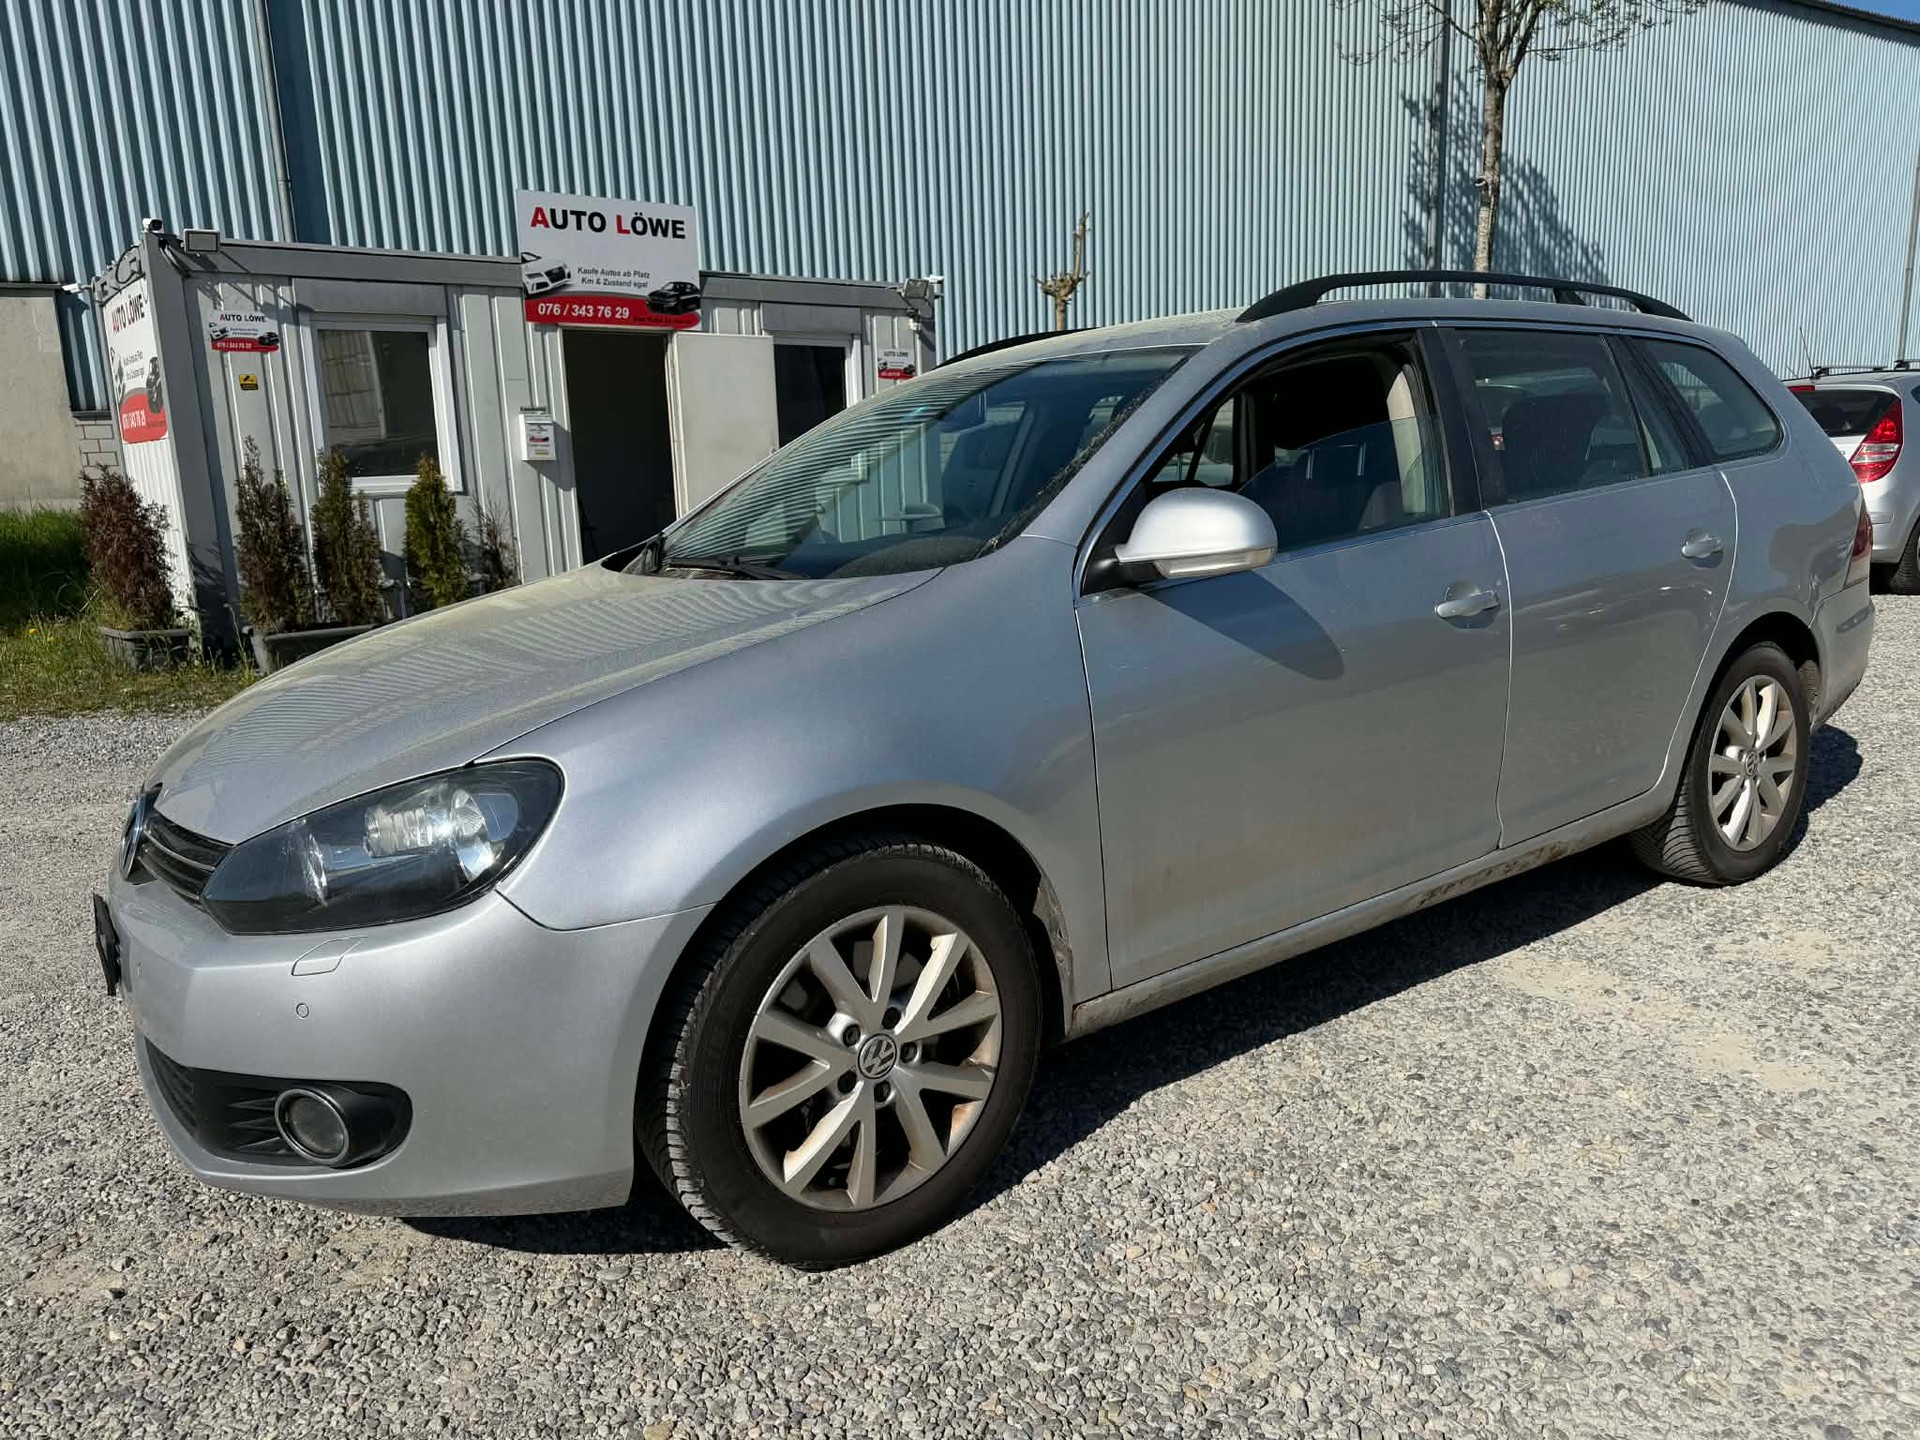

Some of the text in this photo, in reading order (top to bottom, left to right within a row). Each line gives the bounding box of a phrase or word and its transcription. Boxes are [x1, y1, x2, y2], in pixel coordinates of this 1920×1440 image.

[530, 206, 686, 239] AUTO LÖWE
[577, 267, 650, 279] Kaufe Autos ab Platz
[581, 277, 594, 285] Km
[603, 278, 632, 287] Zustand
[633, 281, 648, 289] egal
[112, 294, 145, 334] AUTO LÖWE
[219, 314, 242, 322] AUTO
[538, 303, 561, 316] 076
[572, 304, 593, 317] 343
[597, 305, 612, 318] 76
[615, 307, 629, 319] 29
